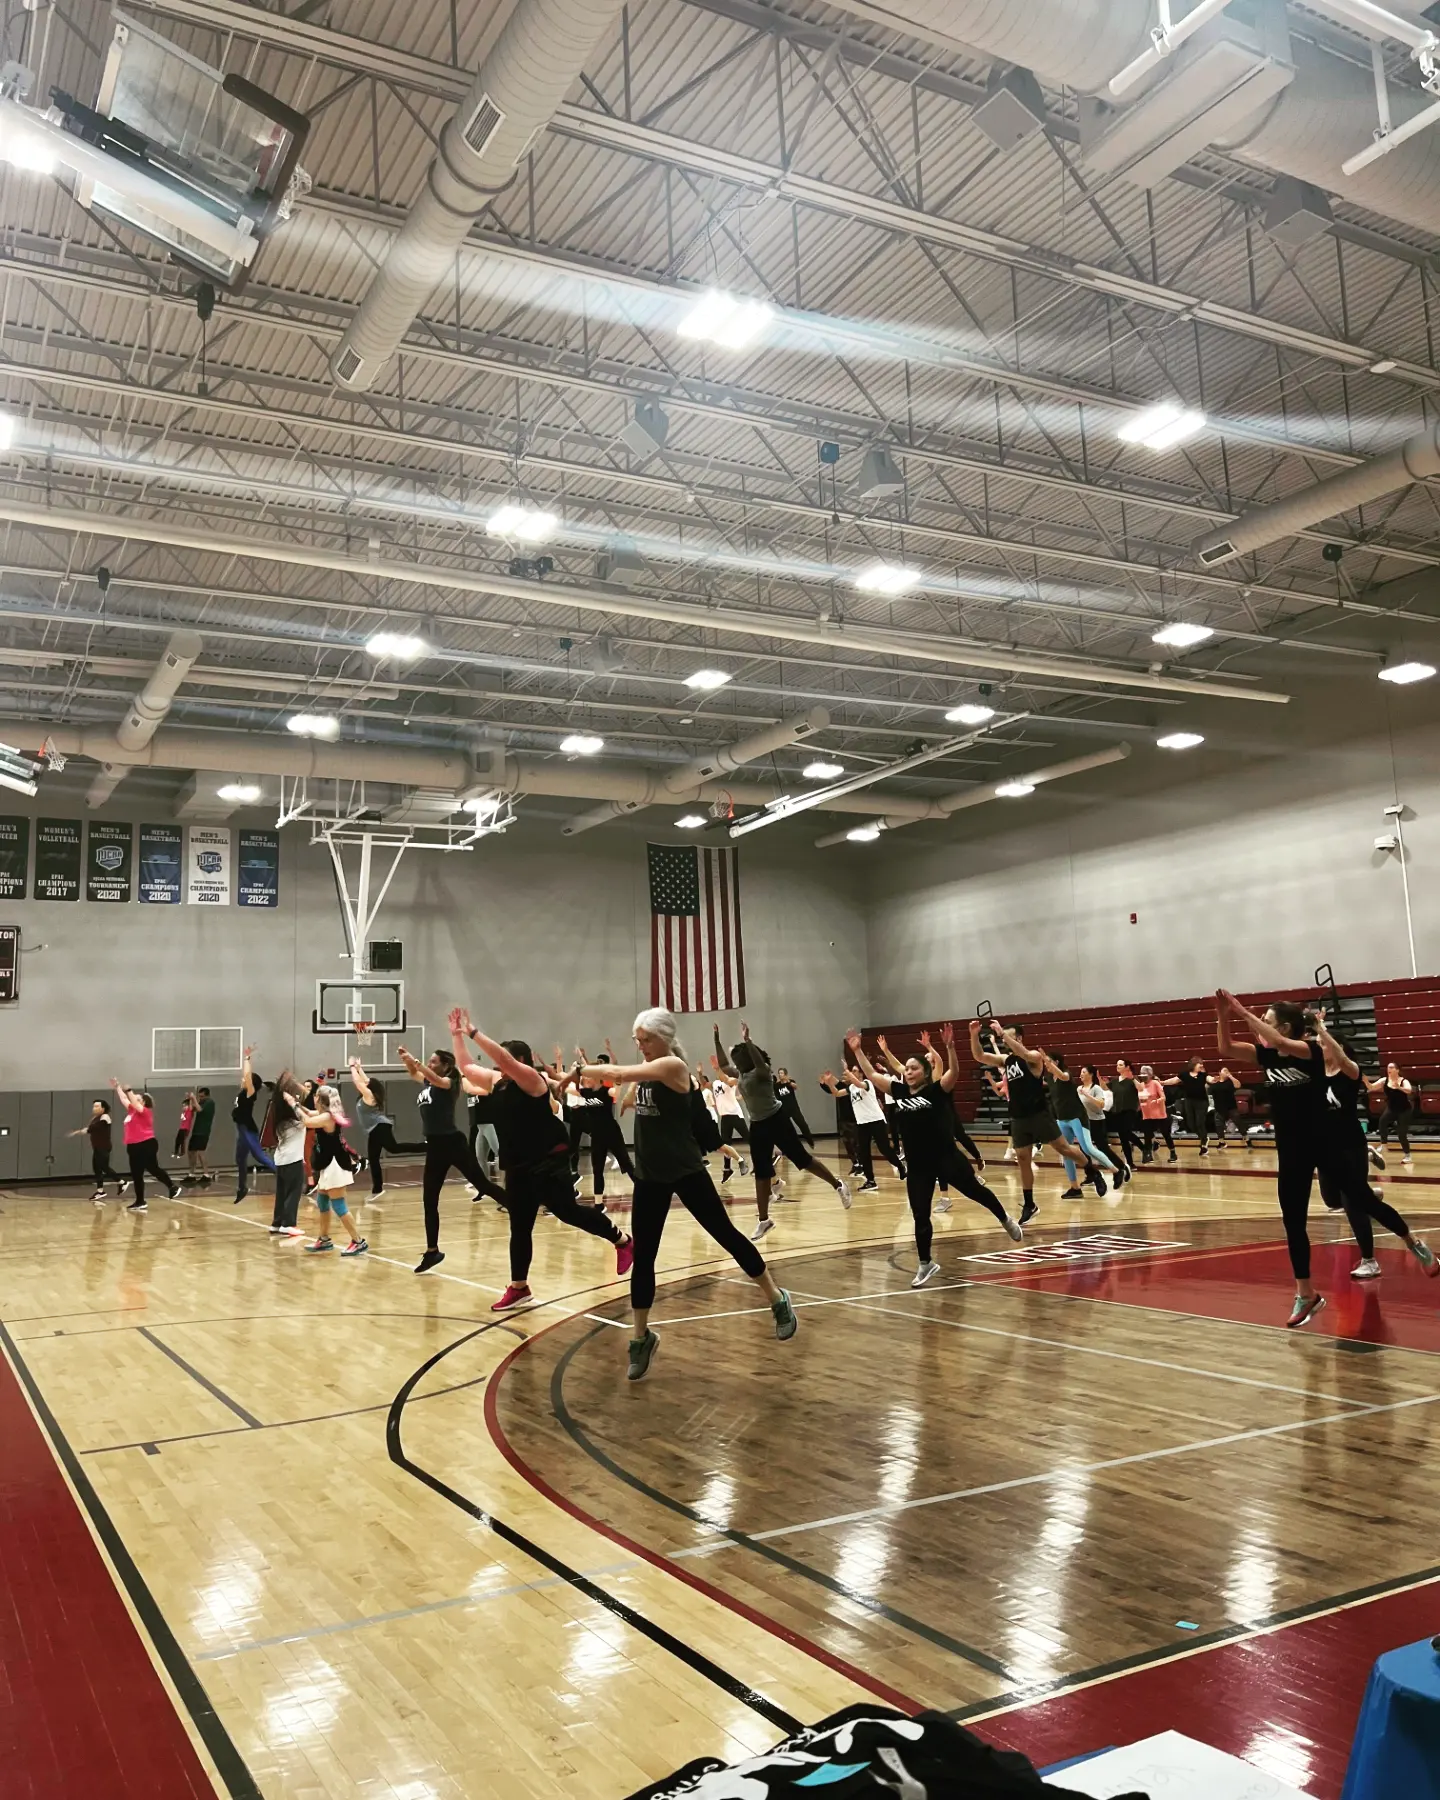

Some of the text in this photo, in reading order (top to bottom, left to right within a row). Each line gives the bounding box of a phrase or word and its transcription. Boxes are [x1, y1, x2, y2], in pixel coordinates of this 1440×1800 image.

[38, 834, 80, 843] VOLLEYBALL
[90, 832, 130, 840] BASKETBALL
[190, 837, 229, 845] BASKETBALL
[240, 840, 277, 848] BASKETBALL
[196, 853, 222, 866] NJCAA
[37, 879, 77, 888] CHAMPIONS
[141, 883, 179, 891] CHAMPIONS
[46, 887, 68, 896] 2017
[97, 889, 121, 900] 2020
[240, 887, 276, 895] CHAMPIONS
[148, 891, 172, 901] 2020
[198, 893, 220, 902] 2020
[247, 894, 269, 905] 2022
[886, 1096, 932, 1110] KIM
